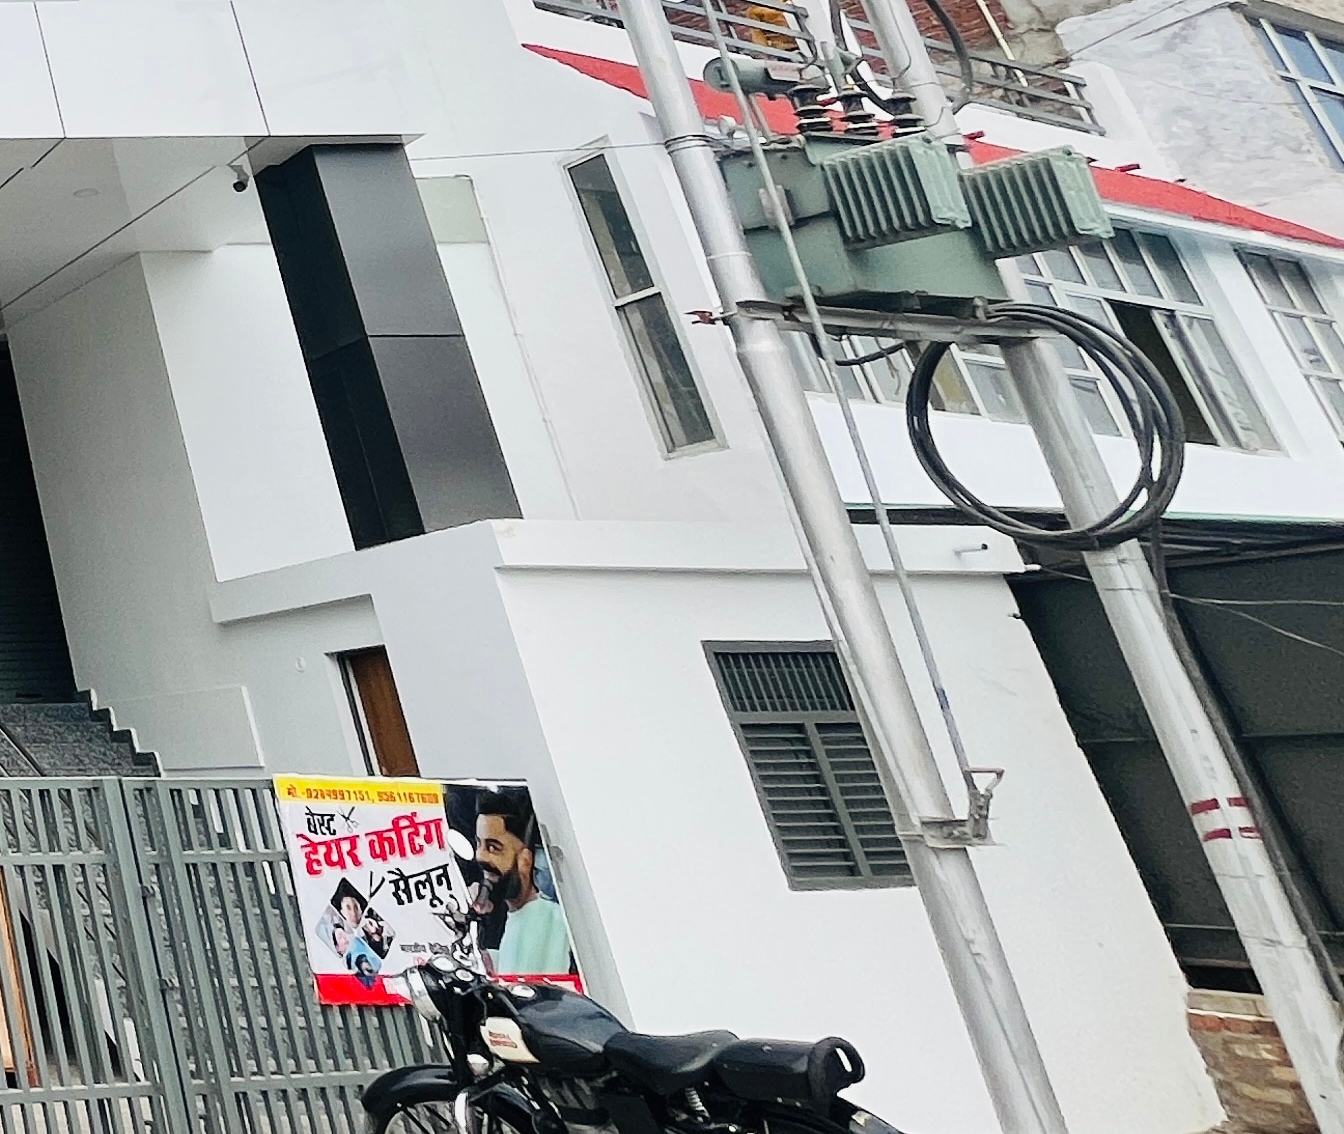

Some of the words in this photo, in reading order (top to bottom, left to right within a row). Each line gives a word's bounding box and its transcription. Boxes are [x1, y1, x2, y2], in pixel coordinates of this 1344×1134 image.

[305, 806, 337, 836] बेस्ट
[296, 834, 362, 876] हेयर
[365, 812, 445, 863] कटिंग
[387, 863, 453, 908] सैलून
